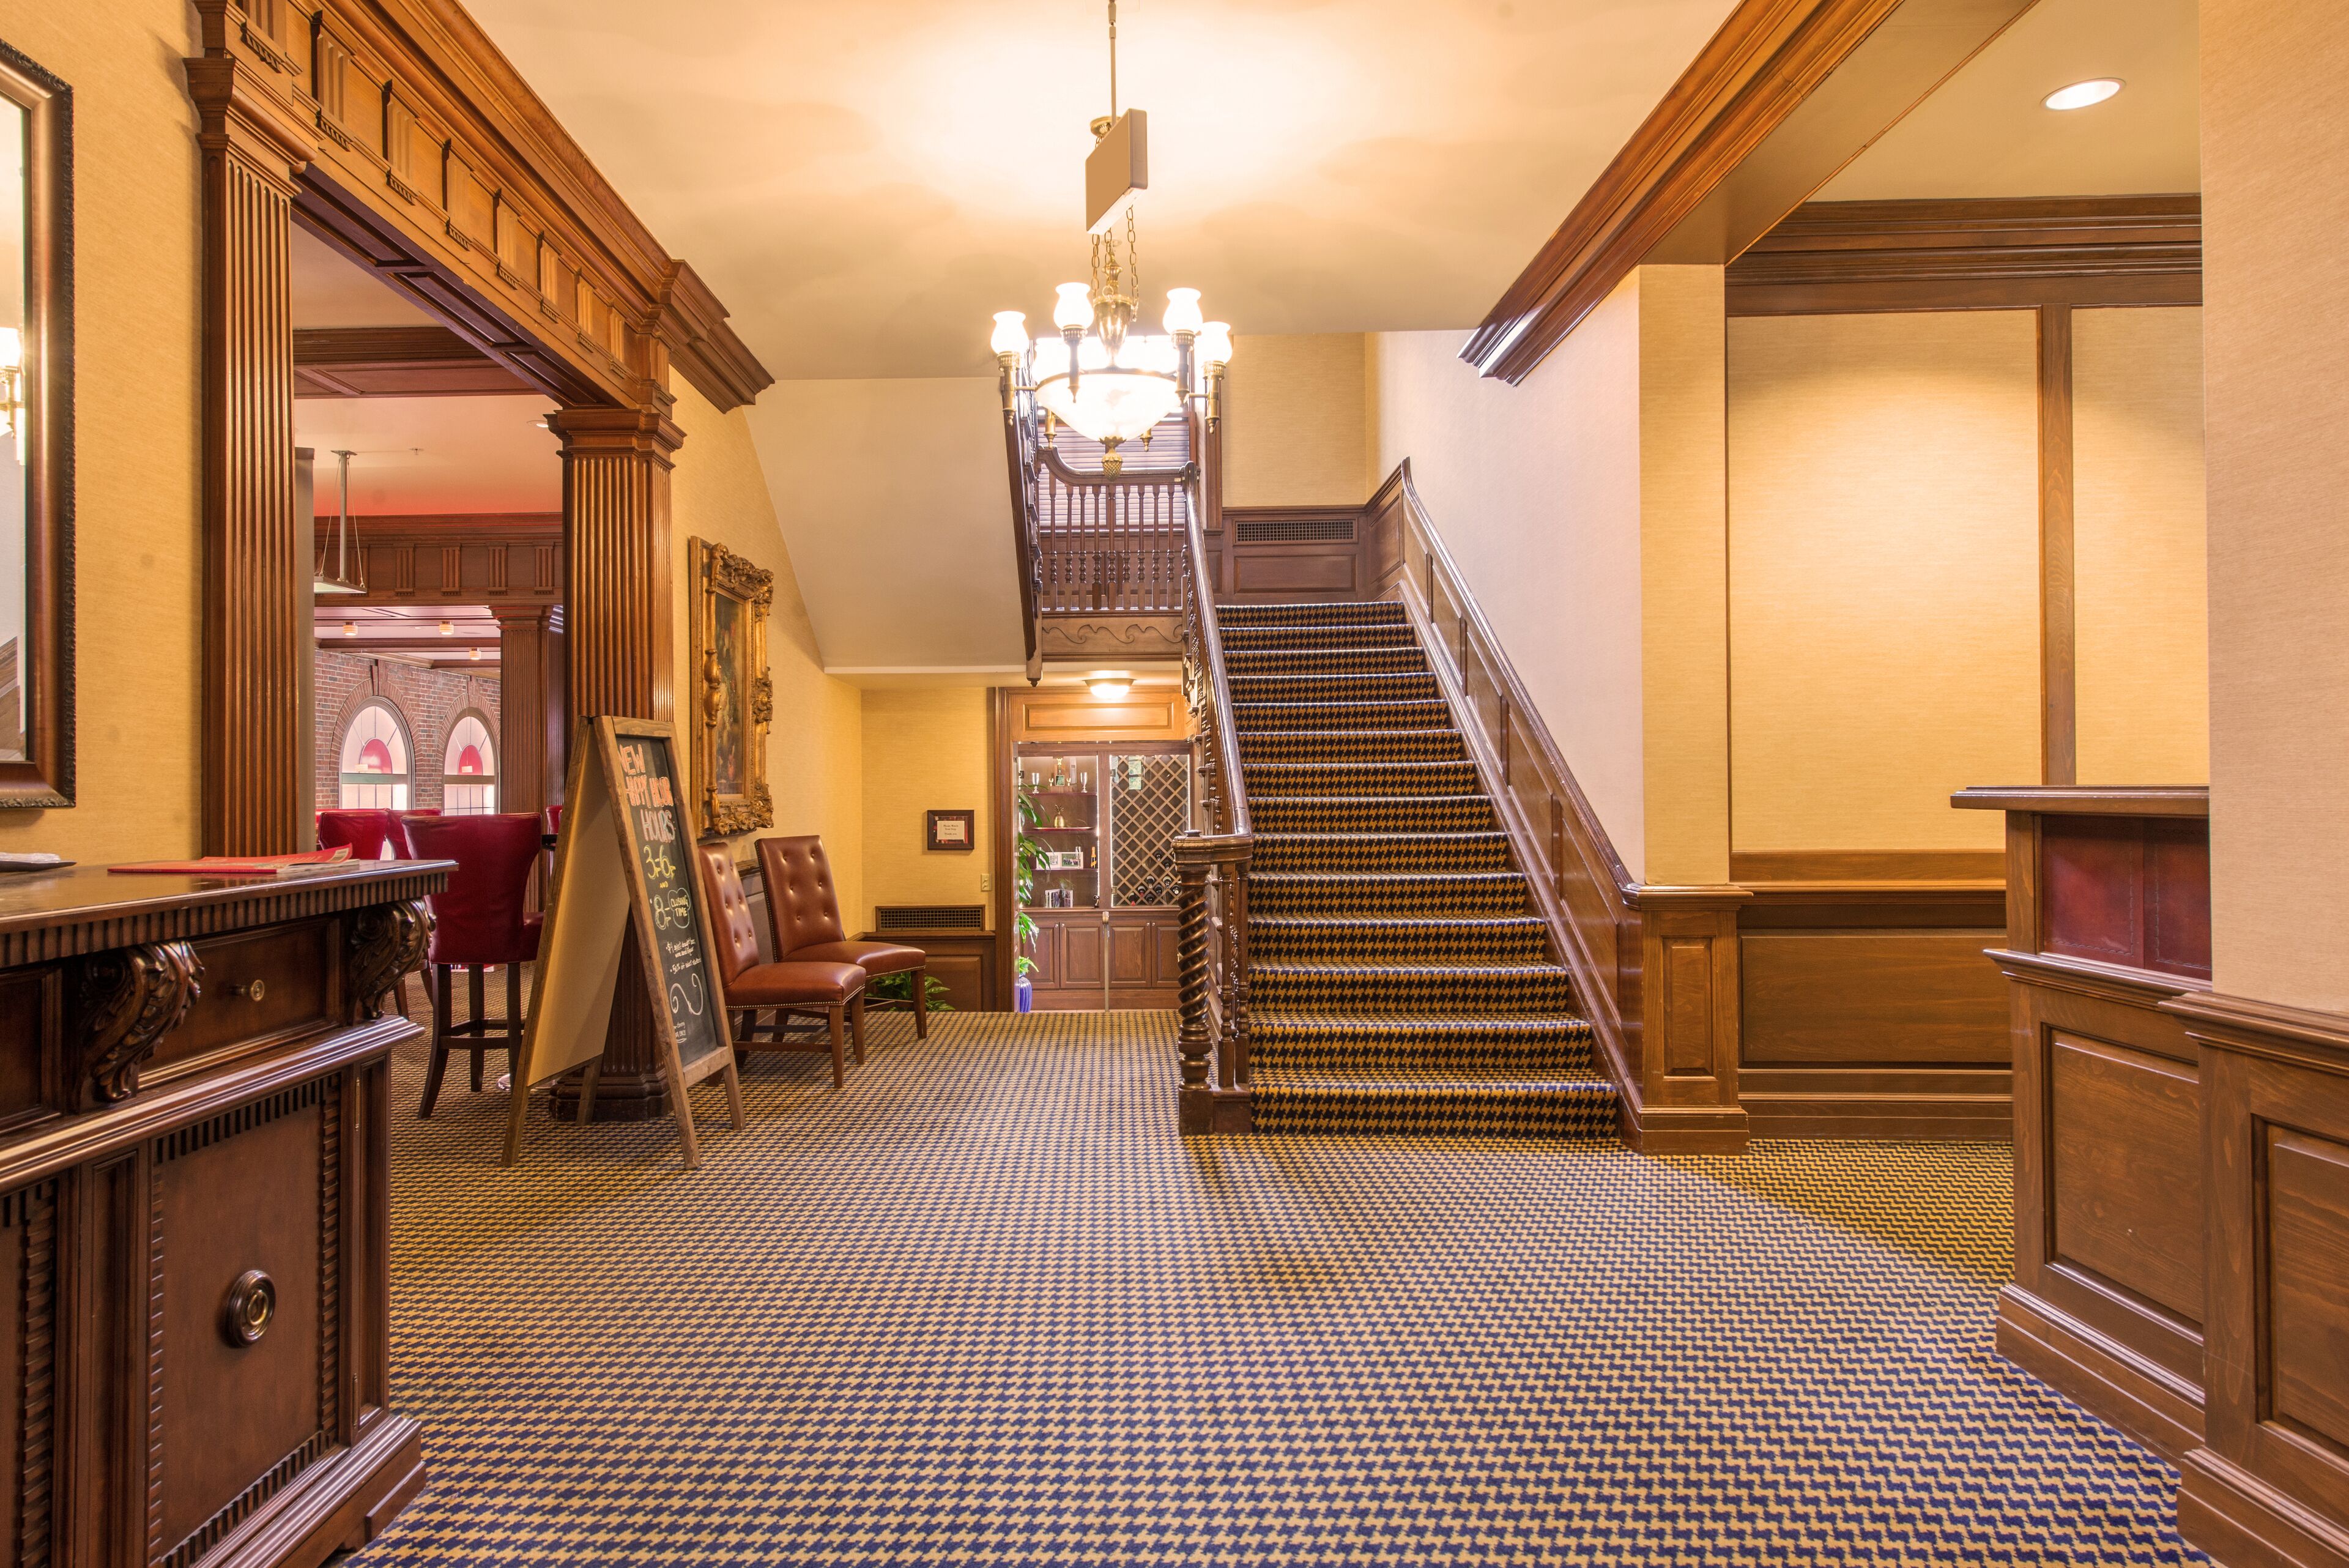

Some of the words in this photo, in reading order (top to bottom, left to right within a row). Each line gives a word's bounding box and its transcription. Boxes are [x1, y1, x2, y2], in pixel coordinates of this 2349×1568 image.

[649, 776, 674, 807] HOUR
[670, 894, 689, 907] CLOSING
[675, 907, 688, 916] TIME
